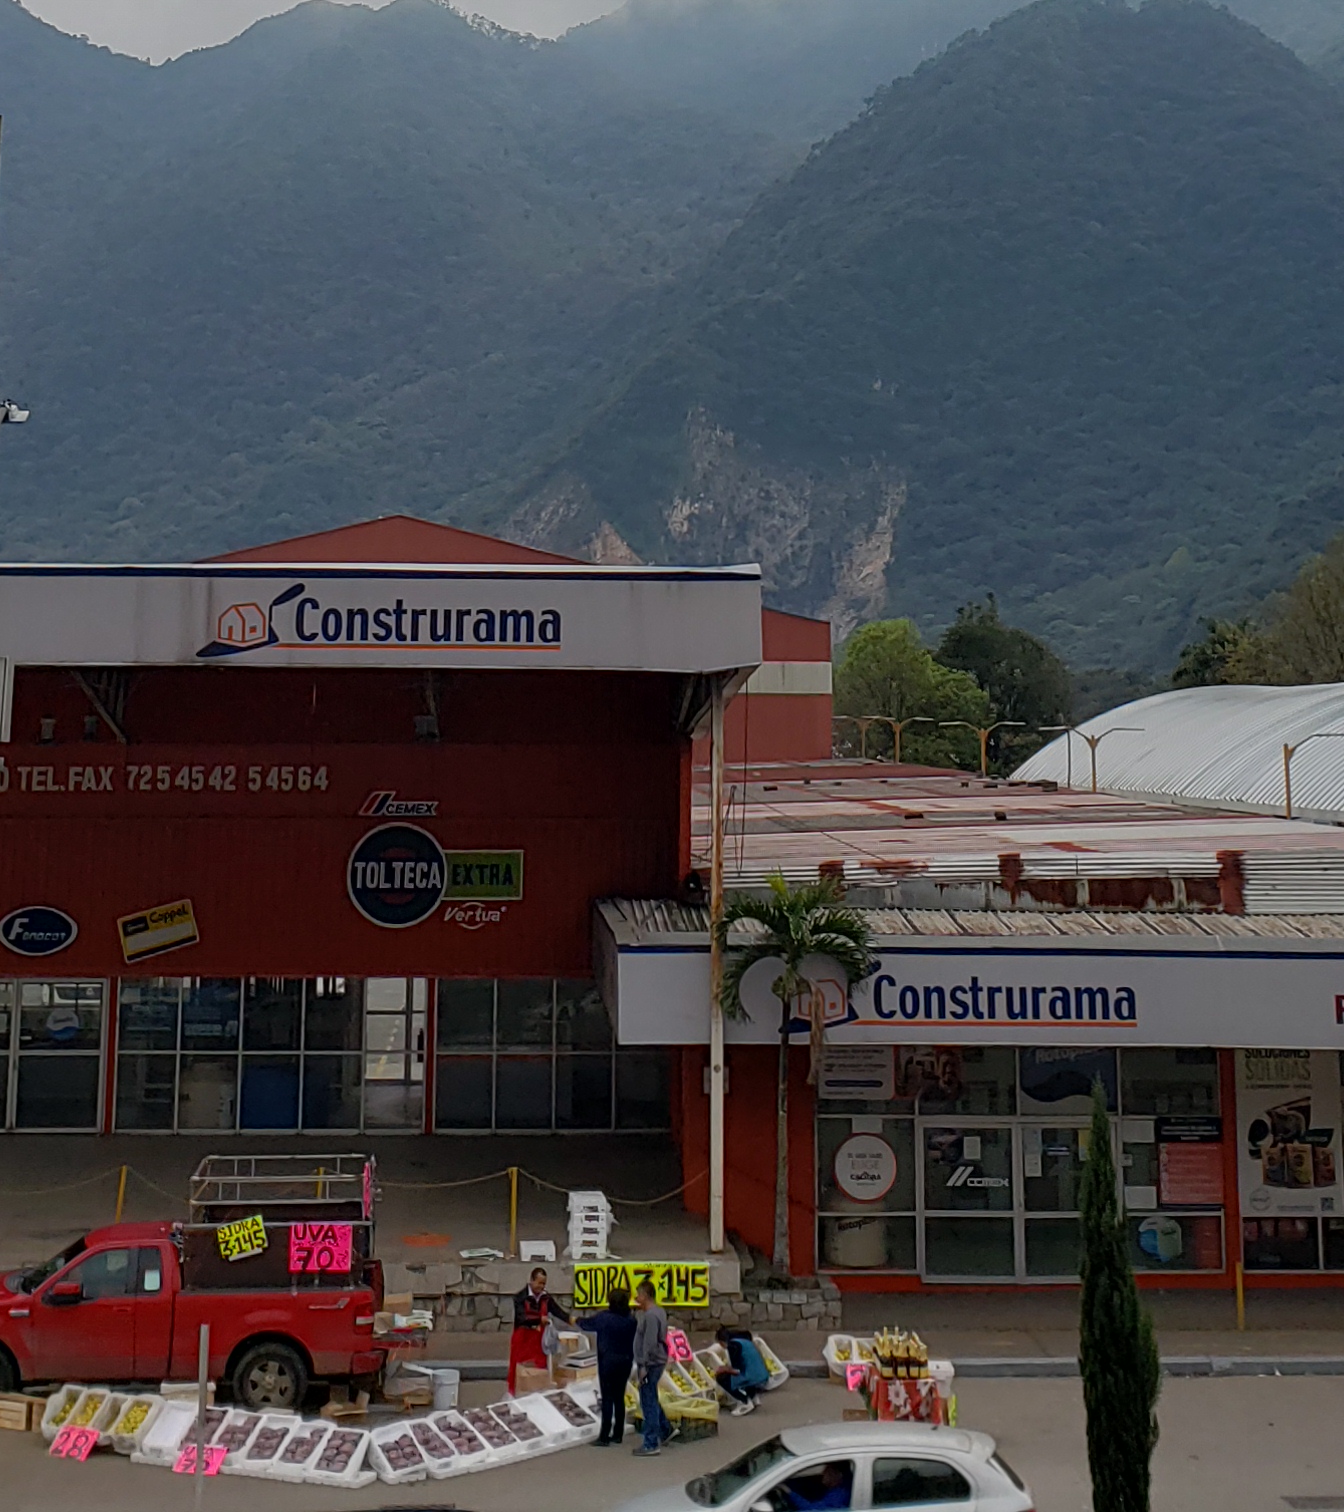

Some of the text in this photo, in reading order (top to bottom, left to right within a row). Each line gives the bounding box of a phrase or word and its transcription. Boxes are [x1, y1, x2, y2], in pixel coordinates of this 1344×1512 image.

[296, 597, 561, 642] Construrama
[385, 803, 435, 814] CEMEX
[355, 861, 513, 889] TOLTECA EXTRA
[873, 974, 1137, 1020] Construrama
[293, 1224, 339, 1243] UVA
